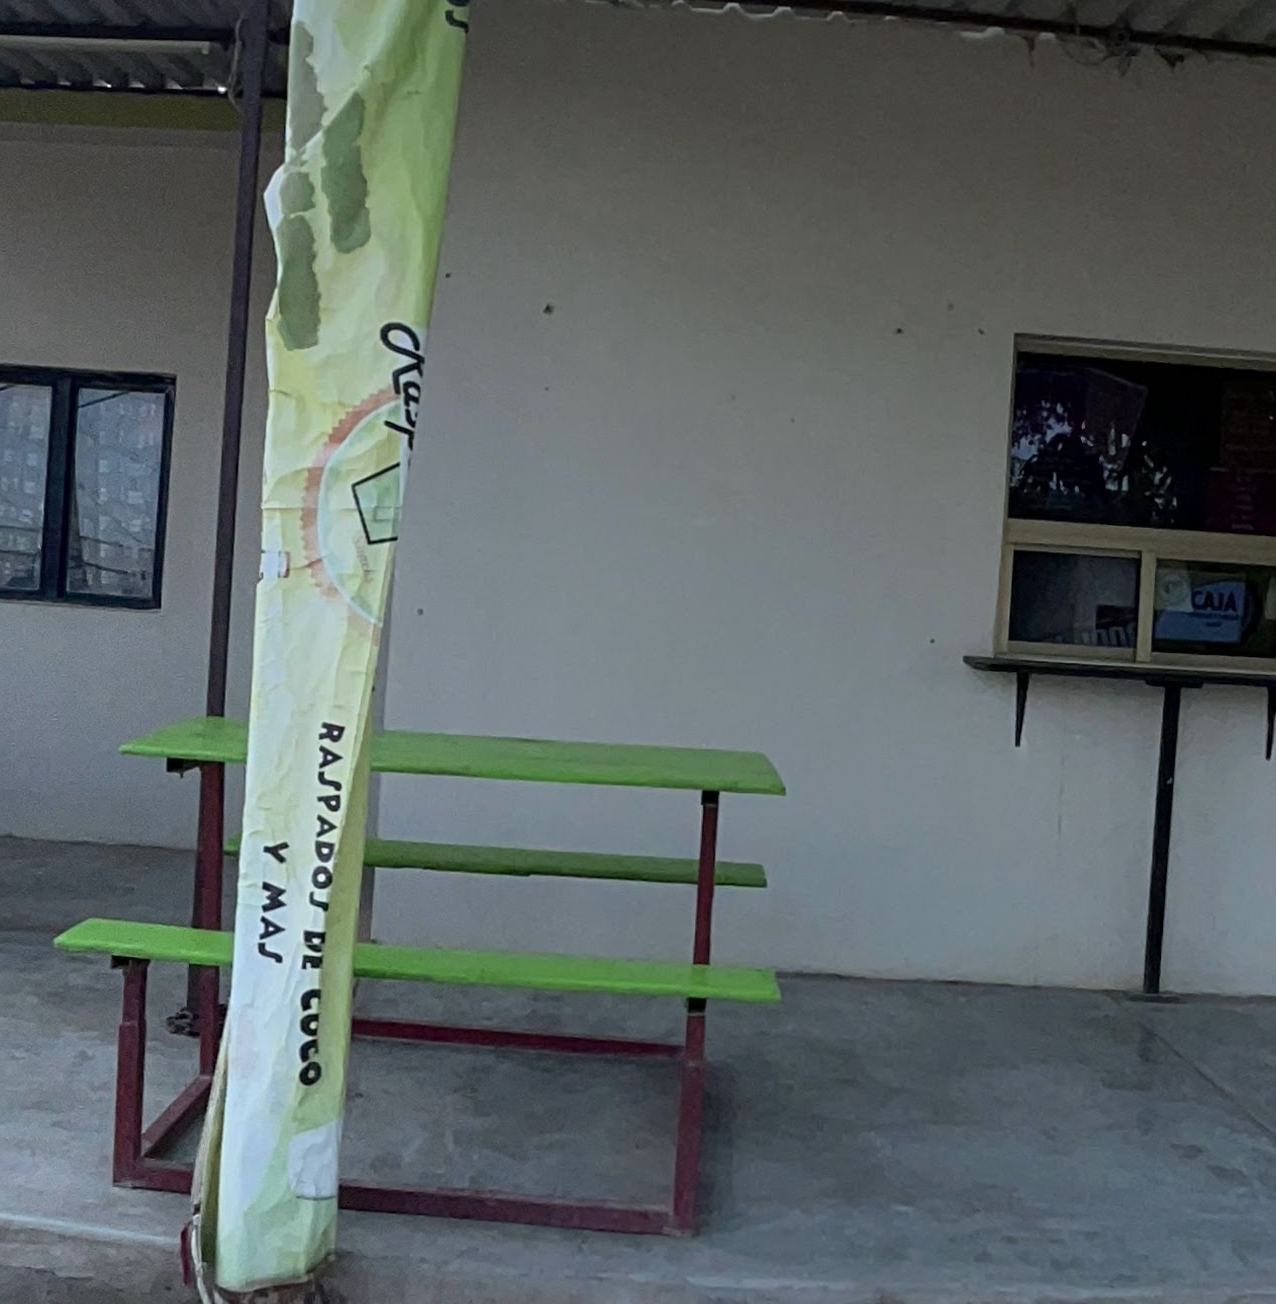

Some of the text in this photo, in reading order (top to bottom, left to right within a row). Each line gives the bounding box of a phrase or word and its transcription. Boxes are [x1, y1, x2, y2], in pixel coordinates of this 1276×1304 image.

[1191, 590, 1237, 613] CAJA
[309, 721, 345, 912] RASPADOS
[258, 841, 290, 964] Y MAS
[301, 930, 327, 970] DE
